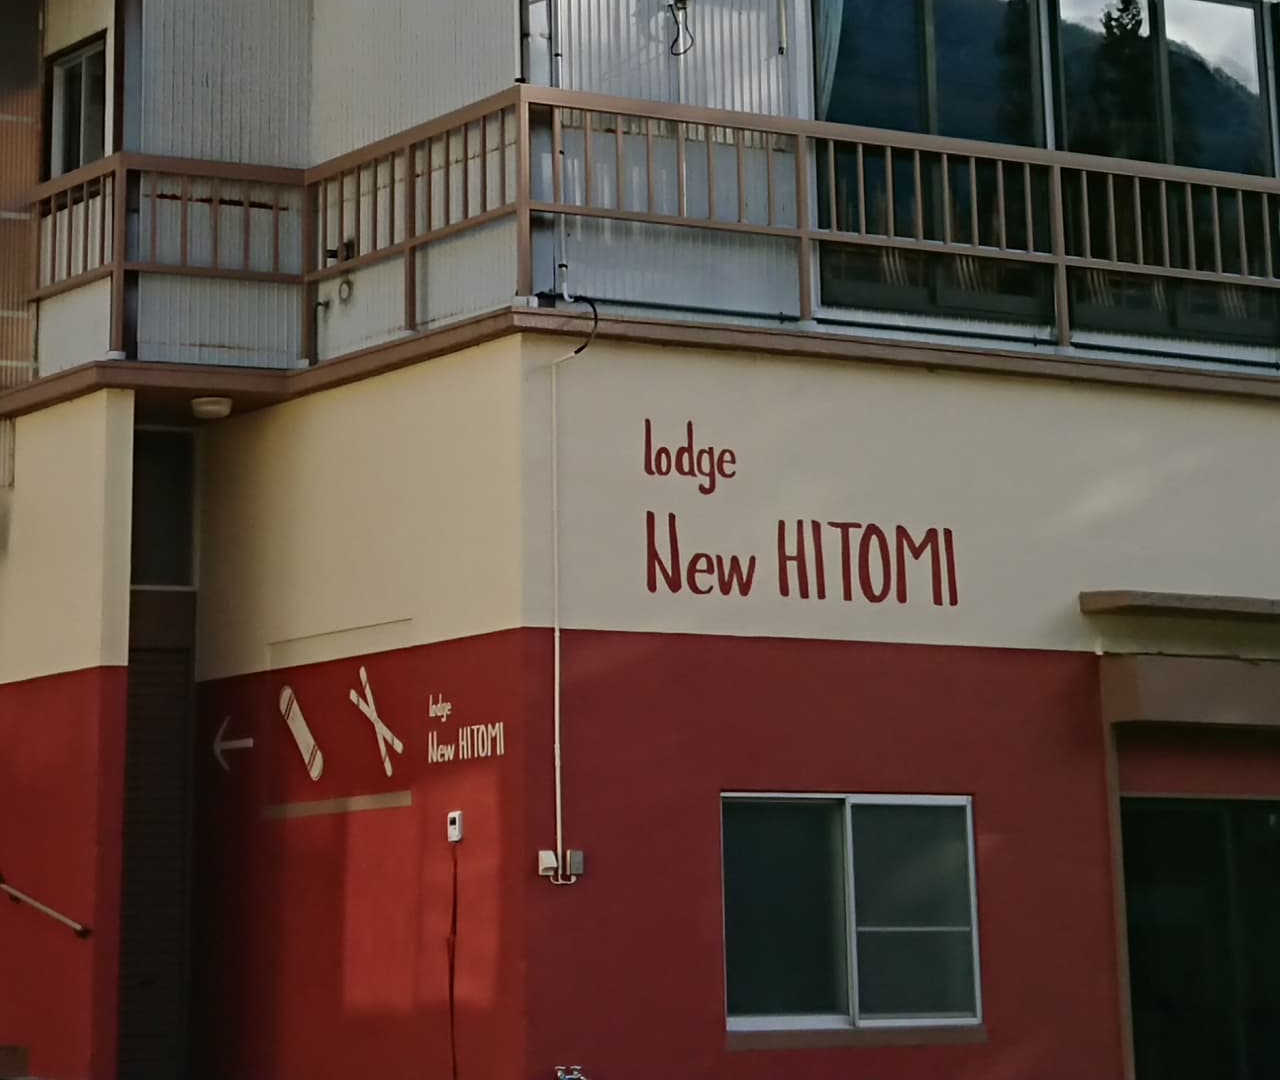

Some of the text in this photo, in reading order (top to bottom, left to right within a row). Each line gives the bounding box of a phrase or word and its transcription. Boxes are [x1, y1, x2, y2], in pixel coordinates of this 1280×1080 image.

[644, 418, 737, 495] lodge
[646, 510, 959, 607] New HITOMI
[429, 693, 452, 722] lodge
[428, 721, 505, 764] New HITOMI
